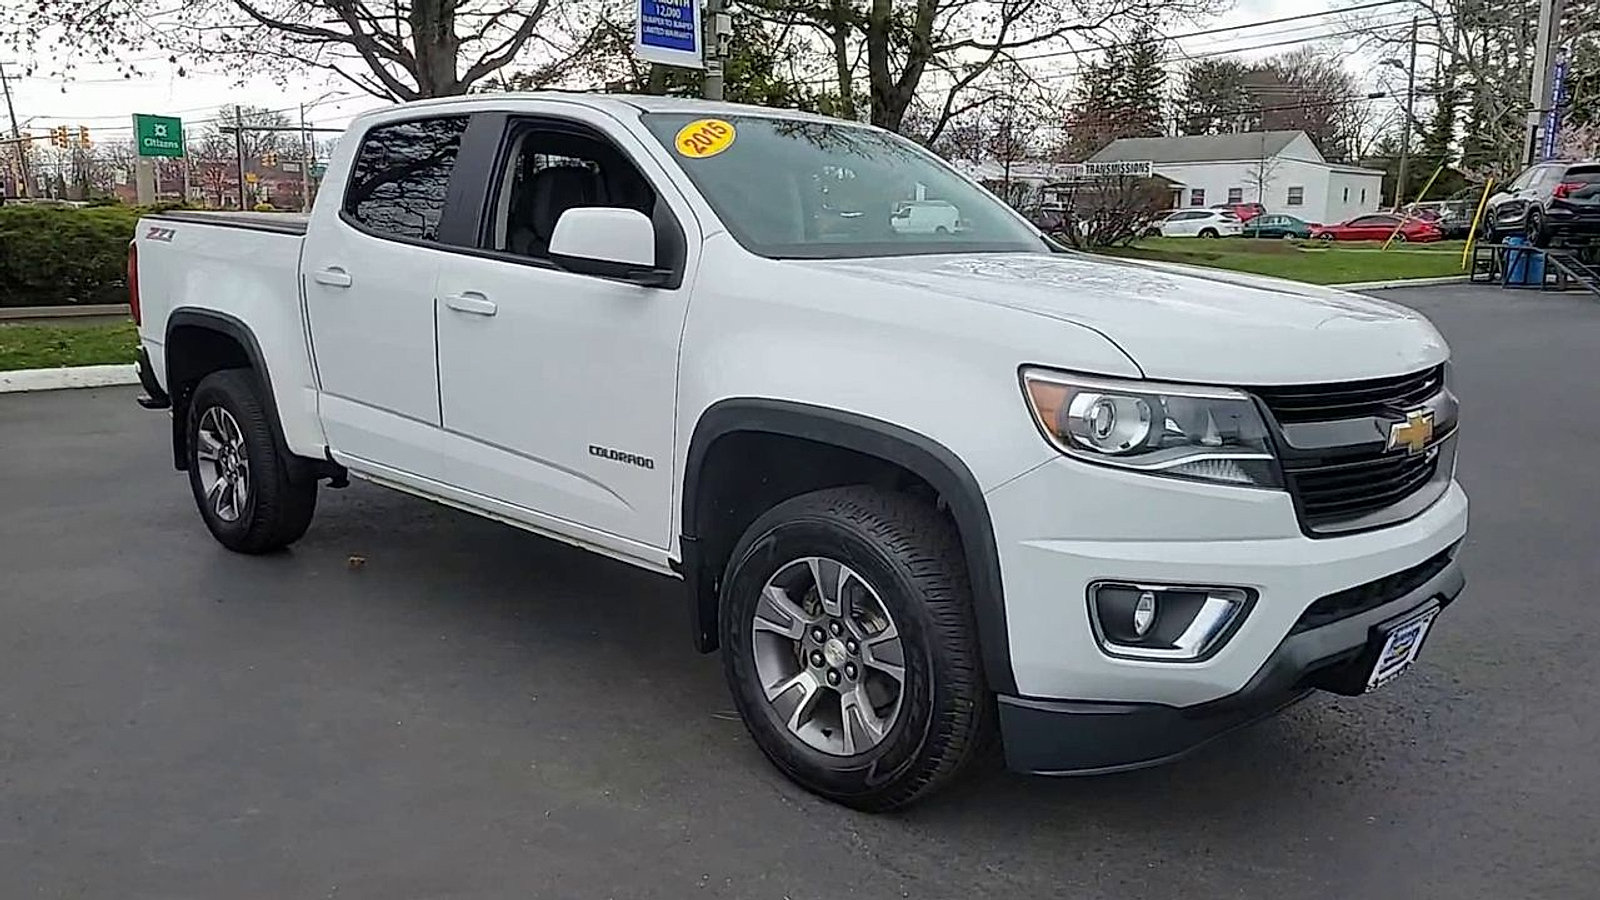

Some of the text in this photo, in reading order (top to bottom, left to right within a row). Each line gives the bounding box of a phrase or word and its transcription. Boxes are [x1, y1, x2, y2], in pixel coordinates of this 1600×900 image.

[655, 4, 682, 19] 12,000
[143, 137, 179, 149] Citizens
[683, 121, 727, 154] 2015
[1085, 162, 1150, 175] TRANSMISSIONS
[145, 227, 175, 242] Z71
[588, 444, 654, 470] COLORADO
